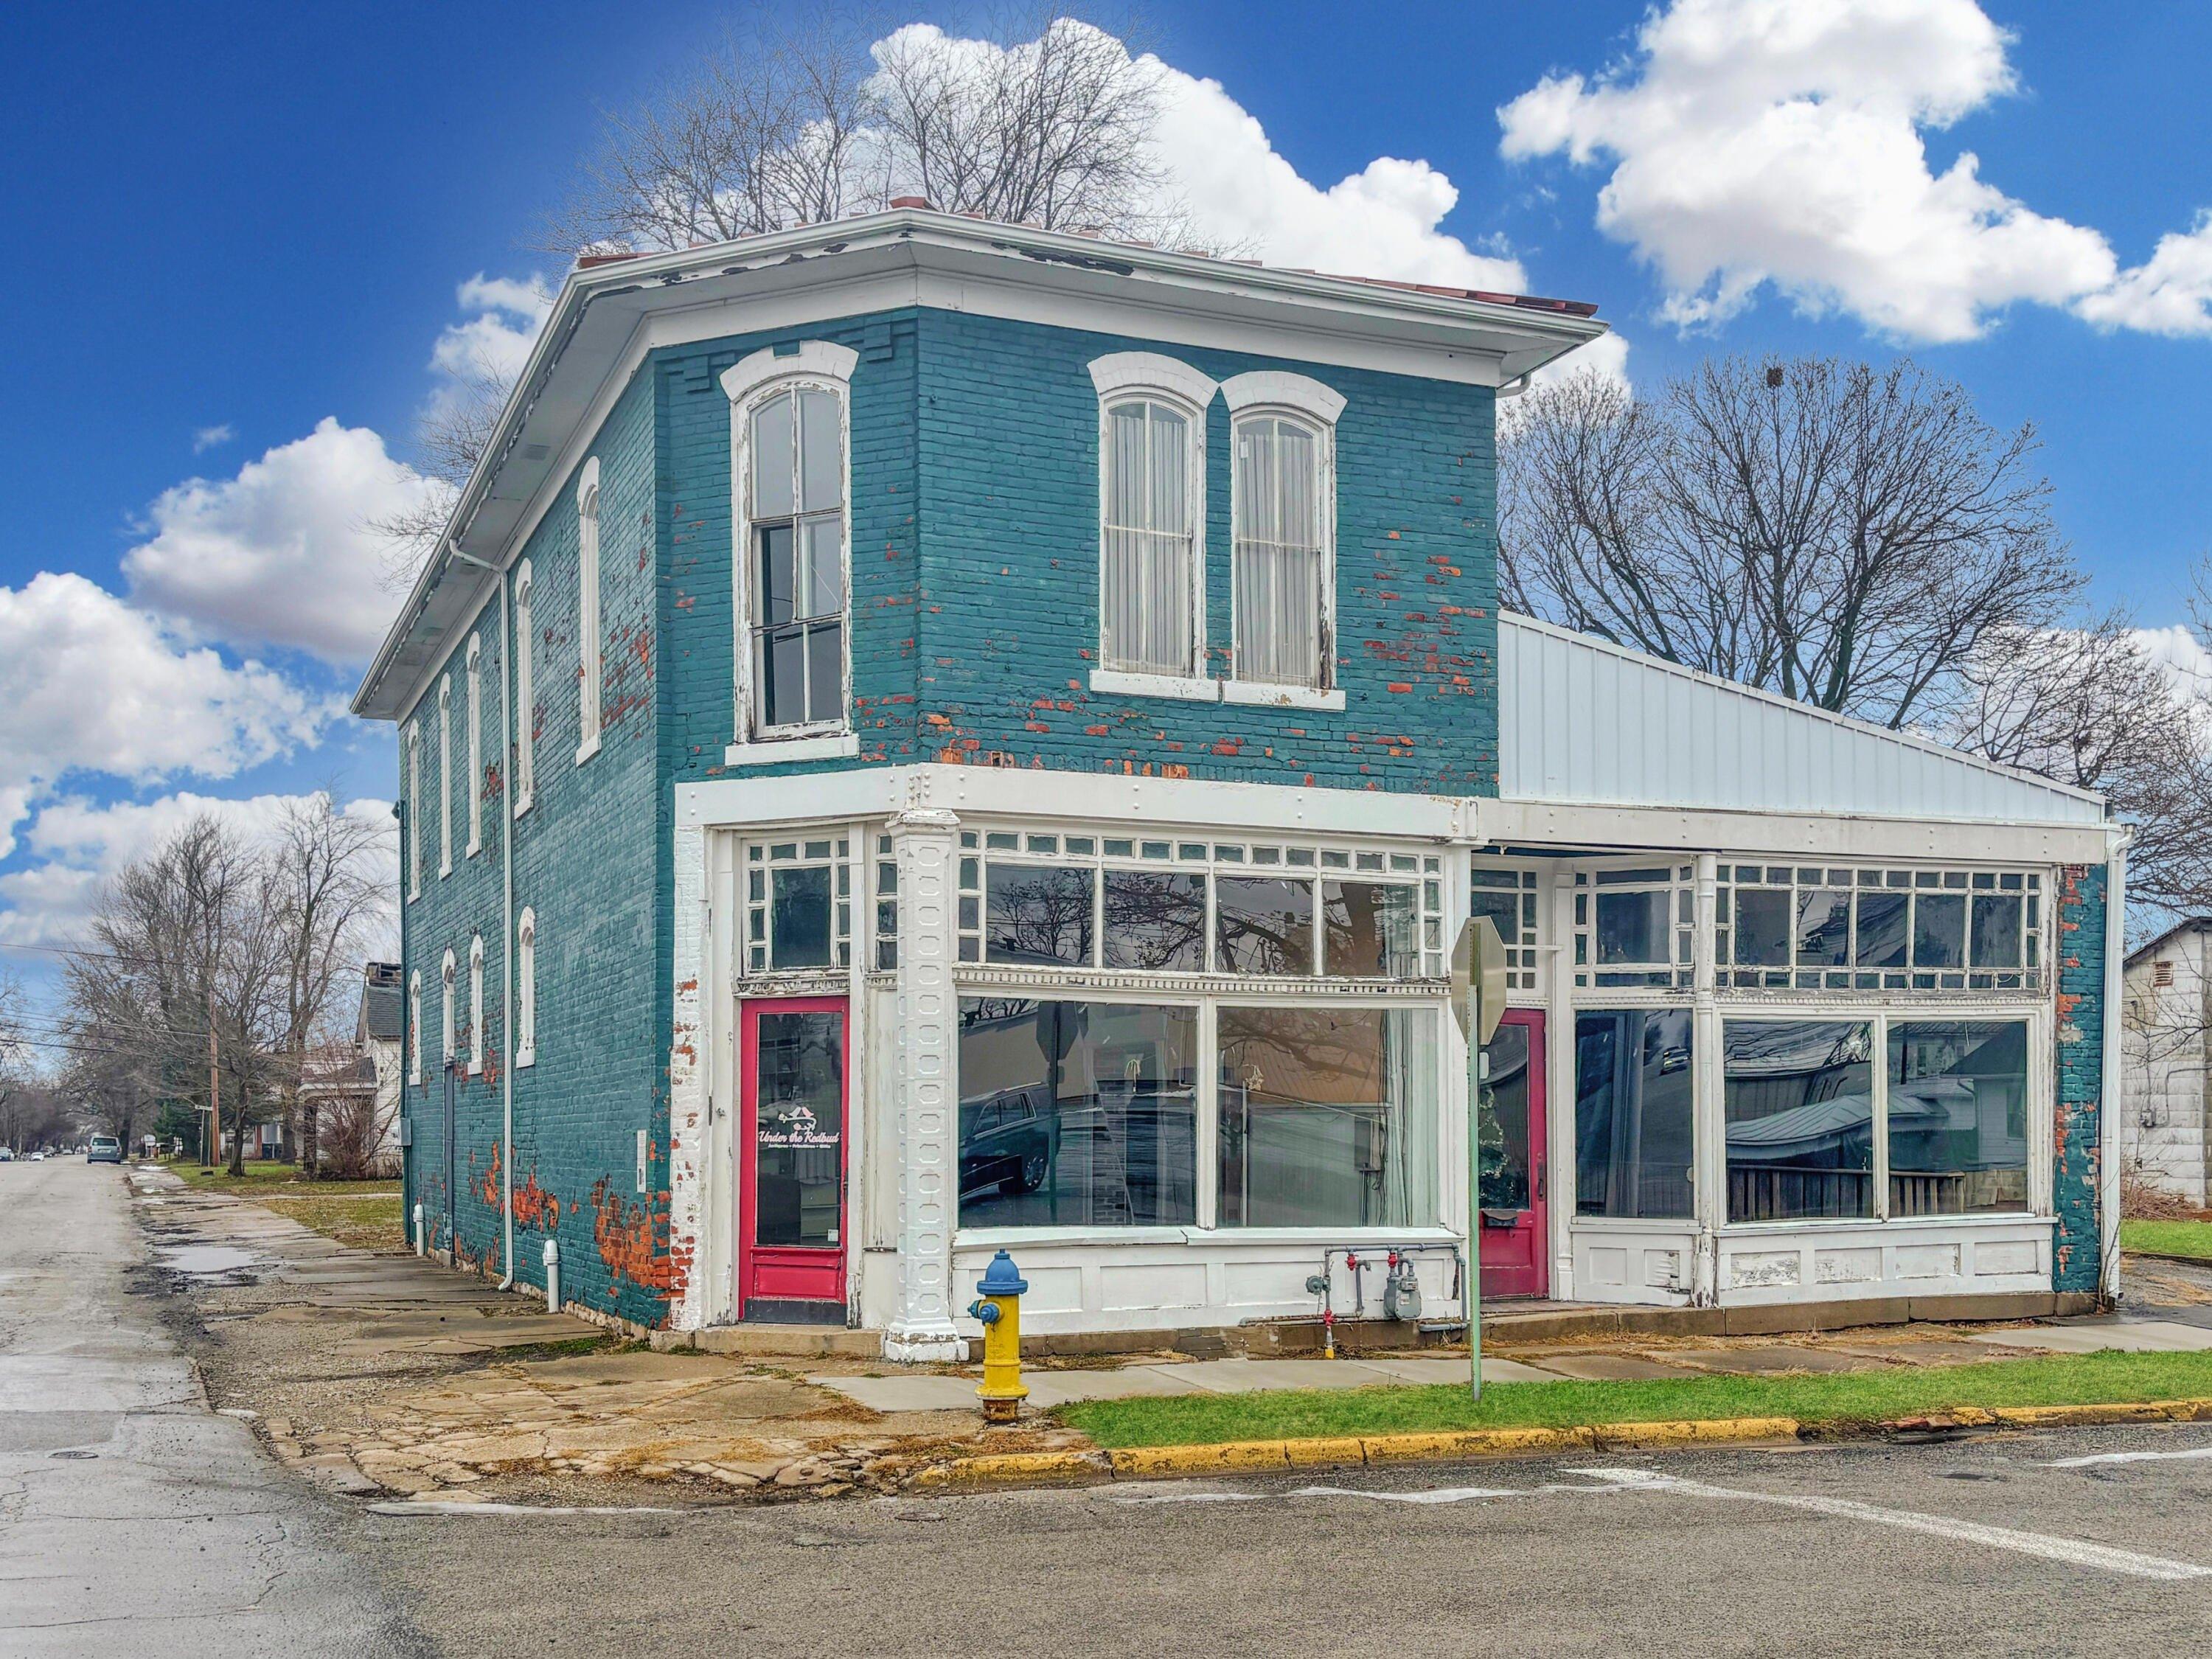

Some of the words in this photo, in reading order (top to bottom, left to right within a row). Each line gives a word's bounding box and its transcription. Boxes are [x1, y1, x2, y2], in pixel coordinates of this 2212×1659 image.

[759, 1130, 787, 1142] Under
[789, 1131, 803, 1142] the
[804, 1131, 840, 1143] Redbud
